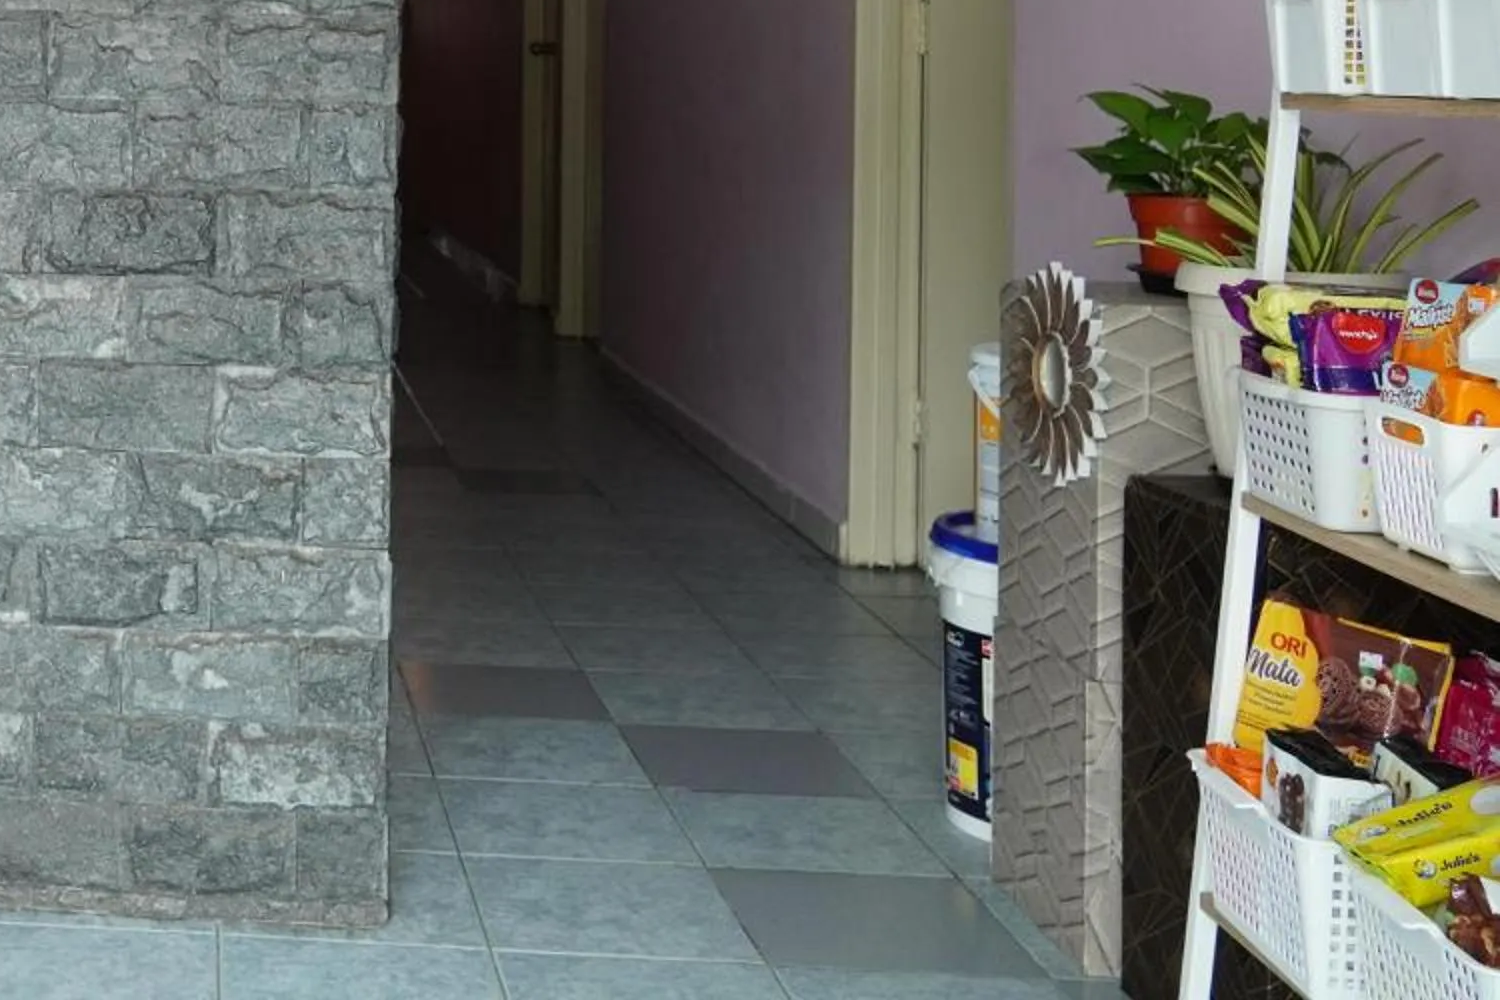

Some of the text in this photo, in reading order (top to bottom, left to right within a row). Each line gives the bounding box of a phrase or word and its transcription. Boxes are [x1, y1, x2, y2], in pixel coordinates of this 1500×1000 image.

[1271, 631, 1308, 659] ORI
[1248, 647, 1301, 687] Nata
[1440, 851, 1481, 872] Julie's
